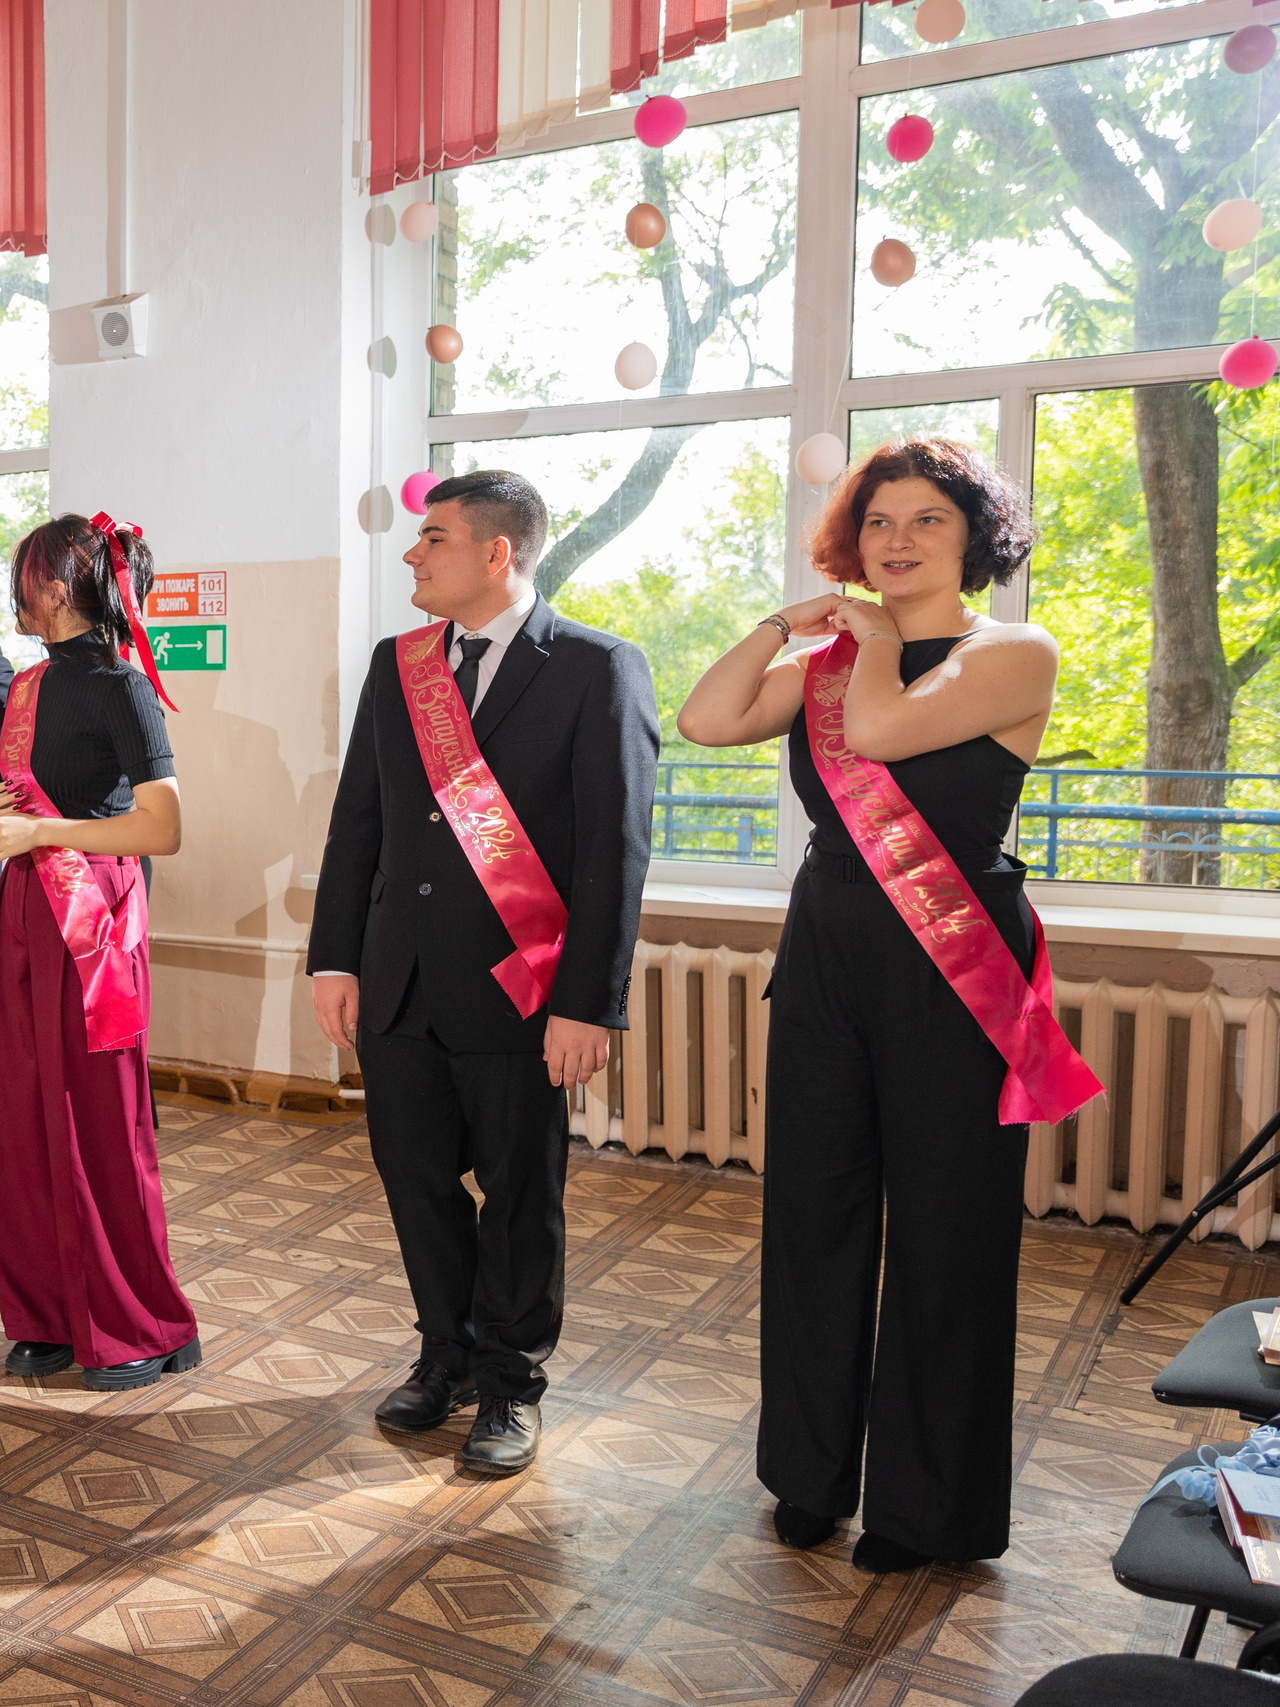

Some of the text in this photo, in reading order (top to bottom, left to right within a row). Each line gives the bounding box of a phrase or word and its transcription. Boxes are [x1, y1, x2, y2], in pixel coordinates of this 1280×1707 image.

[166, 578, 195, 593] ПОЖАРЕ
[201, 579, 222, 591] 101
[156, 597, 189, 612] ЗВОНИТЬ
[201, 600, 223, 612] 112
[408, 662, 529, 860] Выпускник 2024
[469, 756, 489, 786] Данила
[54, 847, 93, 893] 2024
[896, 898, 912, 916] класс
[913, 877, 987, 934] 2024
